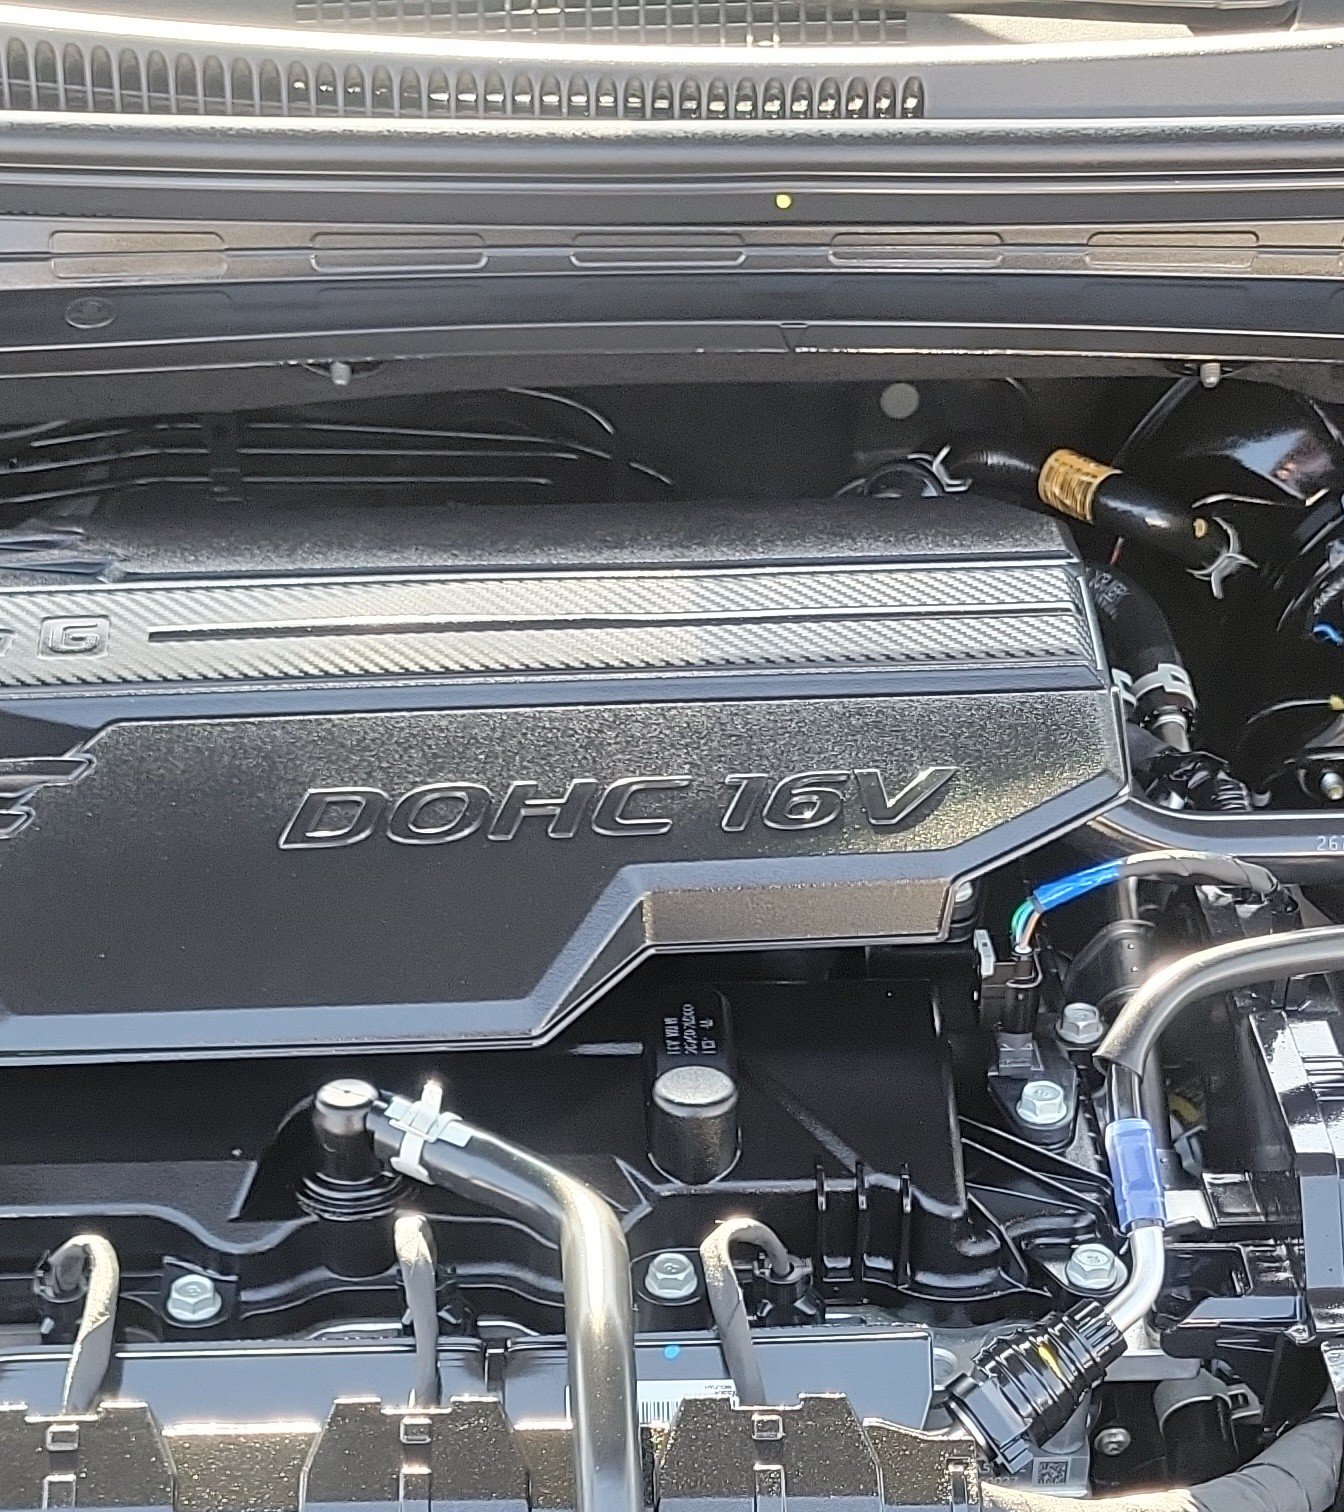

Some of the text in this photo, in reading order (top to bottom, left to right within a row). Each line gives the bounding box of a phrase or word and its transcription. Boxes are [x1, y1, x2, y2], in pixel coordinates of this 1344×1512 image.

[41, 618, 107, 656] G
[278, 765, 959, 850] DOHC 16V
